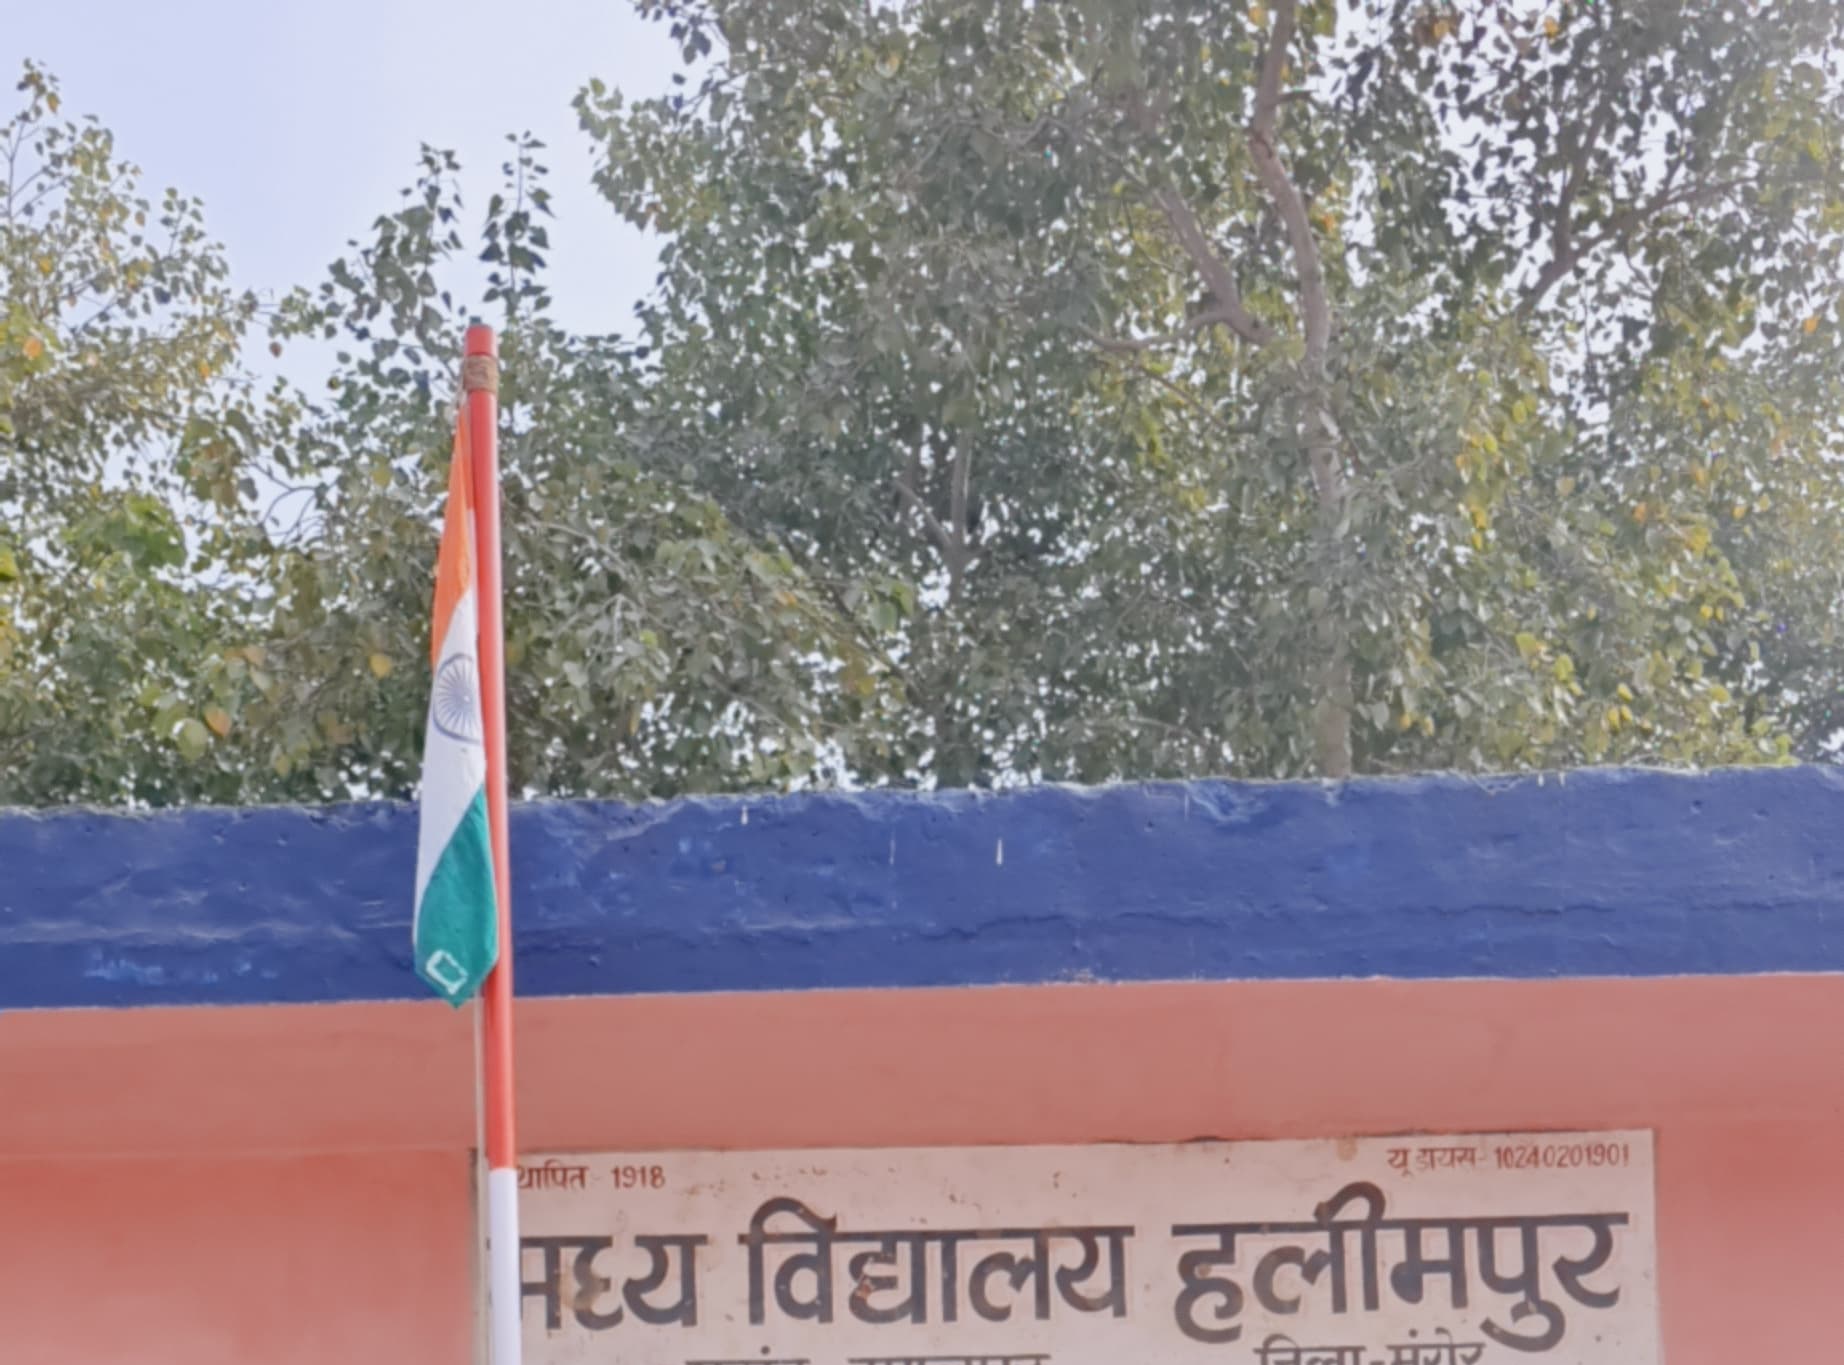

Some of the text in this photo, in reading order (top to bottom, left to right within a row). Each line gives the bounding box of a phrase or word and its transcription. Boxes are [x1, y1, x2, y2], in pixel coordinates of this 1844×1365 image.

[1495, 1143, 1629, 1169] 10240201901
[517, 1159, 666, 1190] थापित 1918
[737, 1196, 1135, 1325] विद्यालय
[1171, 1180, 1630, 1353] हलीमपुर
